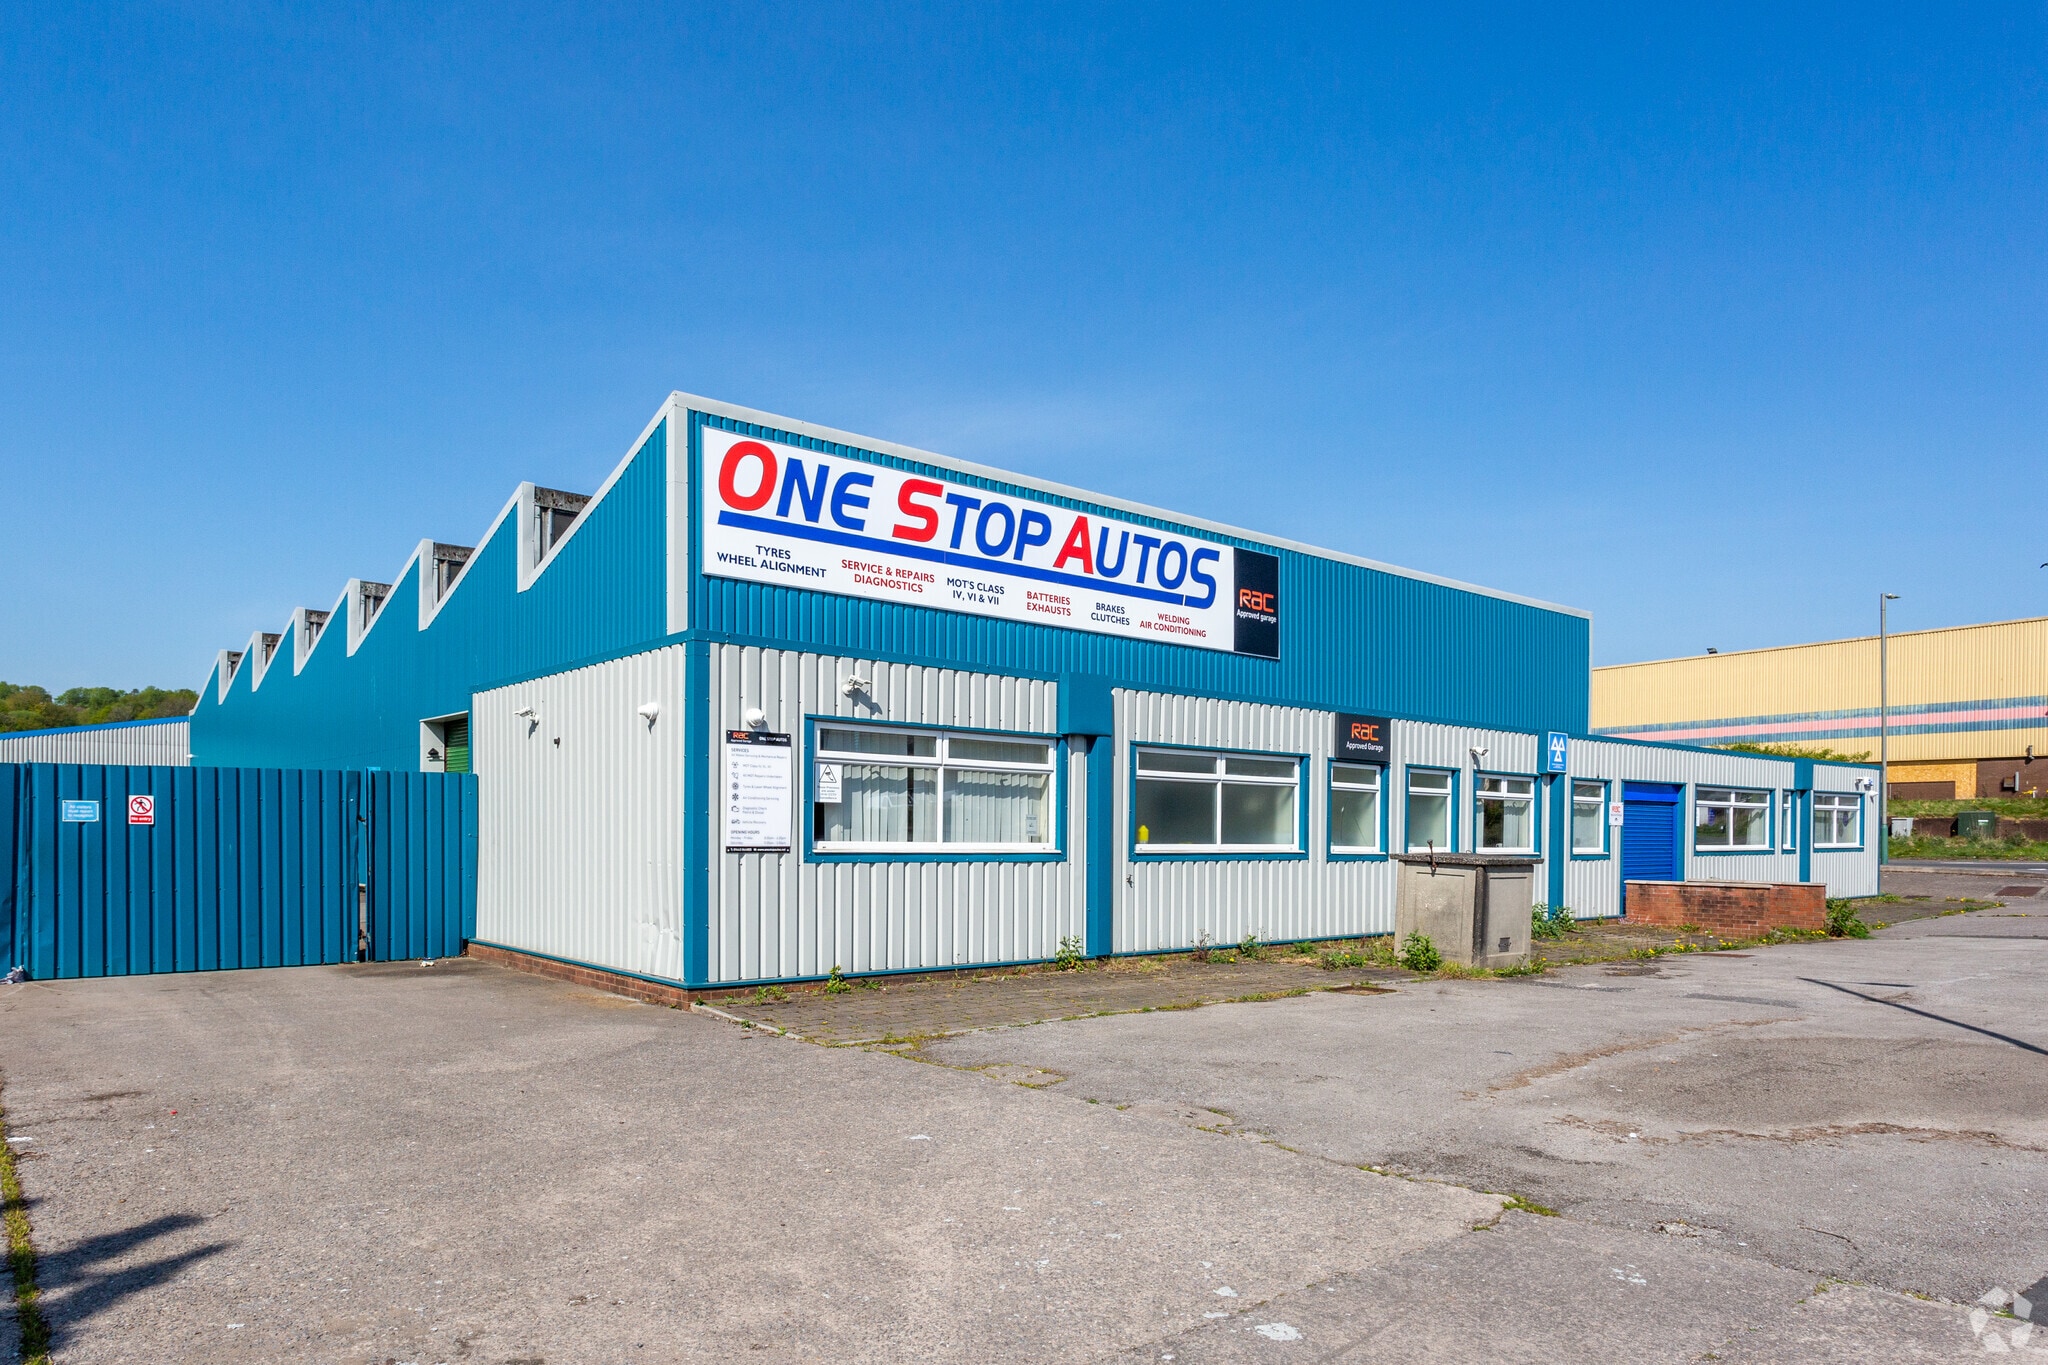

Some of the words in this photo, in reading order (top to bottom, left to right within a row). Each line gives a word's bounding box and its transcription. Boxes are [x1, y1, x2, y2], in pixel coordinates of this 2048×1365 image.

[718, 440, 875, 532] ONE
[892, 478, 1052, 561] STOP
[1052, 515, 1221, 610] AUTOS
[755, 545, 791, 560] TYRES
[717, 552, 758, 568] WHEEL
[760, 560, 827, 578] ALIGNMENT
[841, 559, 884, 575] SERVICE
[885, 566, 893, 576] &
[895, 568, 935, 584] REPAIRS
[854, 573, 923, 593] DIAGNOSTICS
[946, 577, 975, 590] MOT'S
[977, 582, 1005, 595] CLASS
[952, 589, 965, 601] IV,
[967, 591, 977, 602] VI
[978, 594, 985, 603] &
[987, 595, 1000, 606] VII
[1026, 590, 1071, 606] BATTERIES
[1026, 602, 1072, 617] EXHAUSTS
[1095, 602, 1126, 615] BRAKES
[1236, 608, 1260, 622] Approved
[1260, 612, 1277, 624] garage
[1090, 612, 1130, 626] CLUTCHES
[1157, 613, 1190, 626] WELDING
[1139, 620, 1152, 630] AIR
[1153, 622, 1207, 638] CONDITIONING
[1346, 741, 1367, 751] Approved
[1367, 742, 1384, 753] Garage
